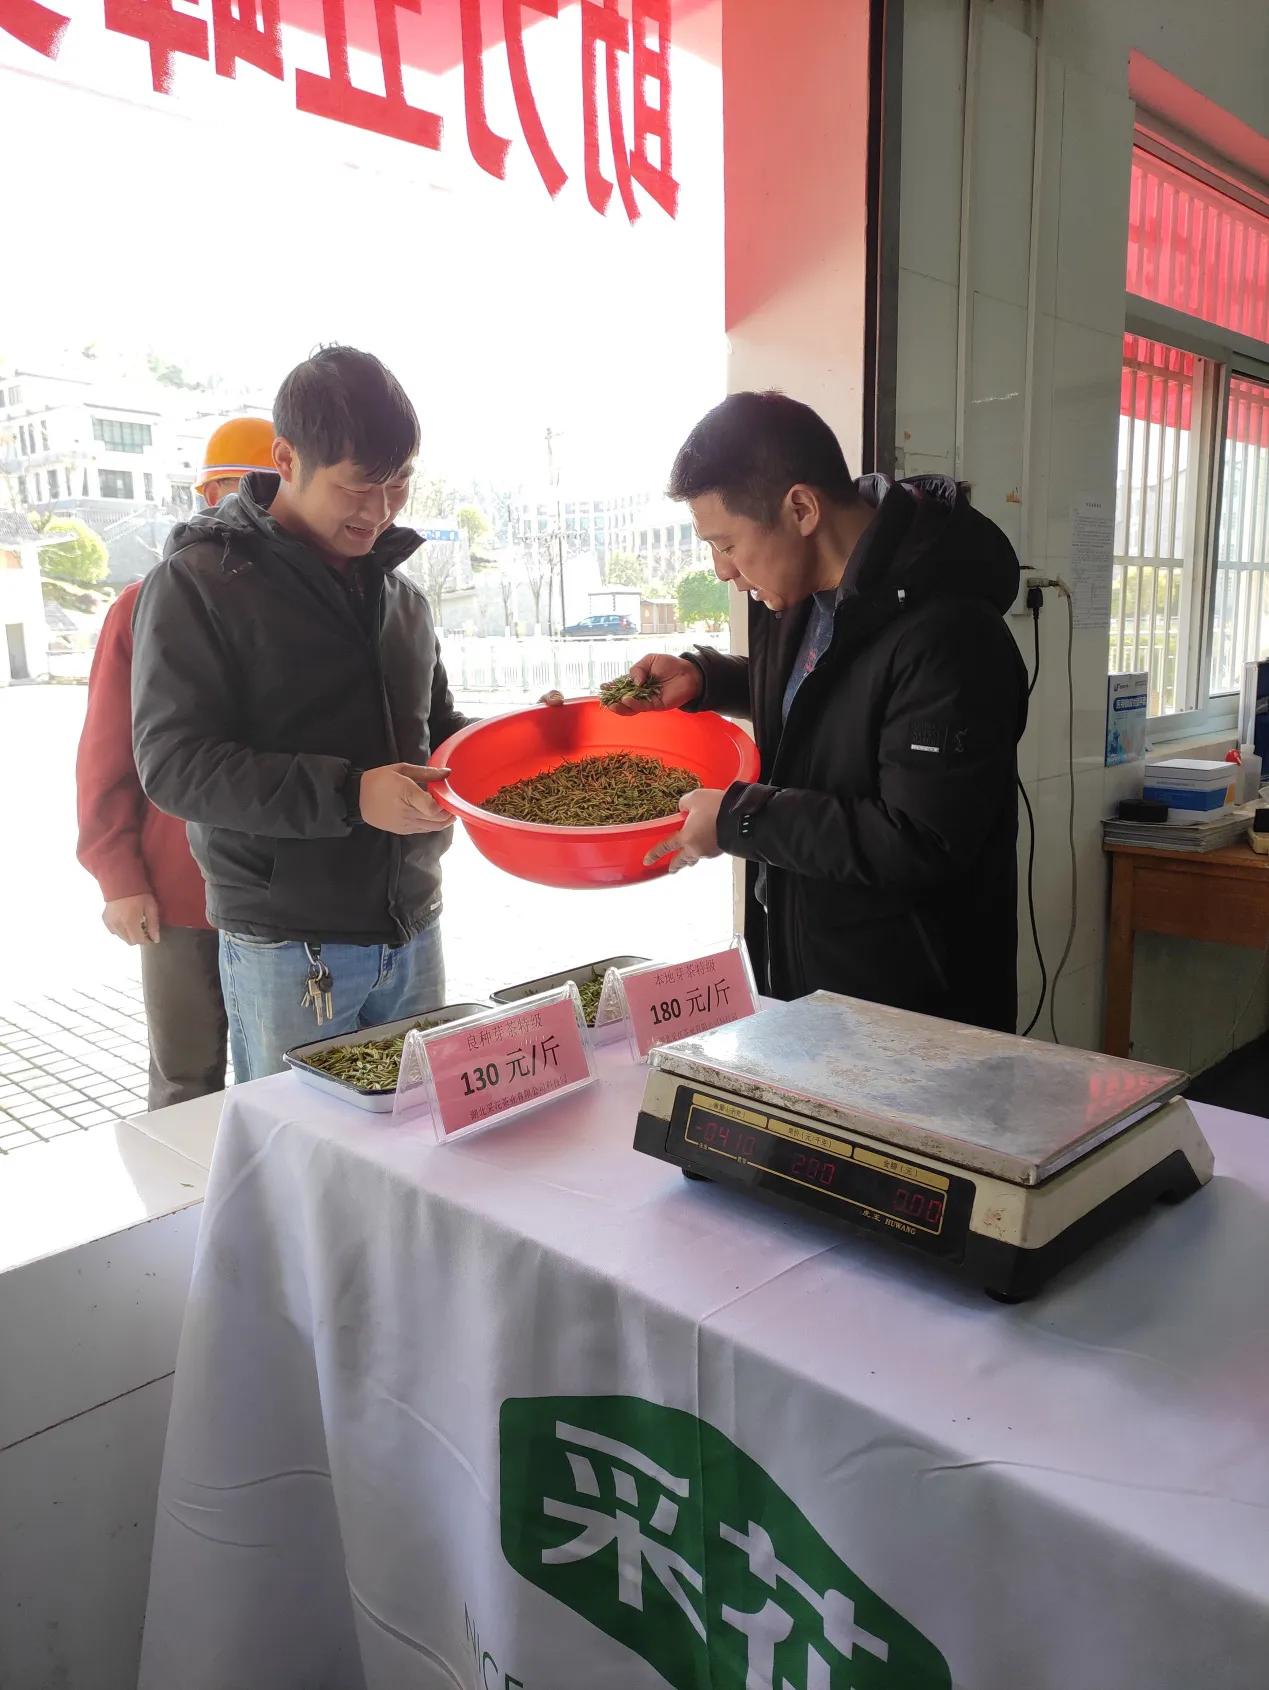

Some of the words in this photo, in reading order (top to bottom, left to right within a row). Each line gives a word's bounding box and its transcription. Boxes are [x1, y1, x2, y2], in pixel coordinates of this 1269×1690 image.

[650, 998, 682, 1026] 180
[685, 977, 731, 1017] 元/斤
[460, 1062, 500, 1096] 130
[505, 1035, 560, 1084] 元/斤
[884, 1217, 917, 1236] HUWANG
